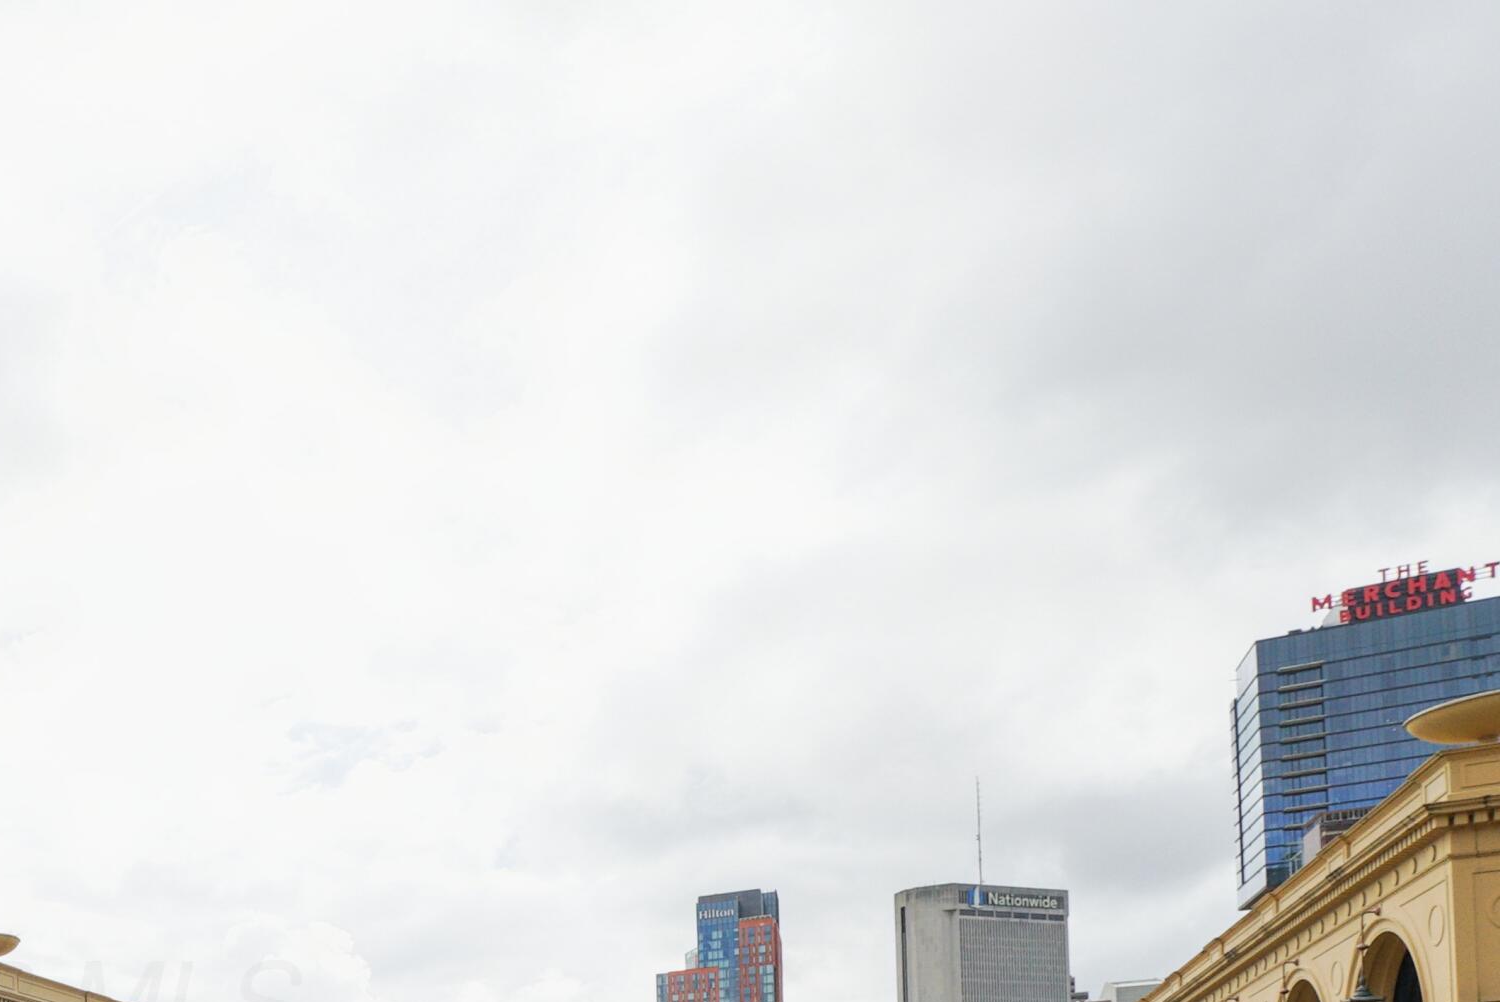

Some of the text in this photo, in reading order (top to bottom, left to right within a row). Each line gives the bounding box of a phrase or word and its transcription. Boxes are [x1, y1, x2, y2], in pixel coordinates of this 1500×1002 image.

[1378, 560, 1429, 582] THE
[1311, 561, 1500, 612] MERCHANT
[1339, 587, 1473, 624] BUILDING
[987, 892, 1058, 909] Nationwide
[699, 909, 734, 920] Hilton
